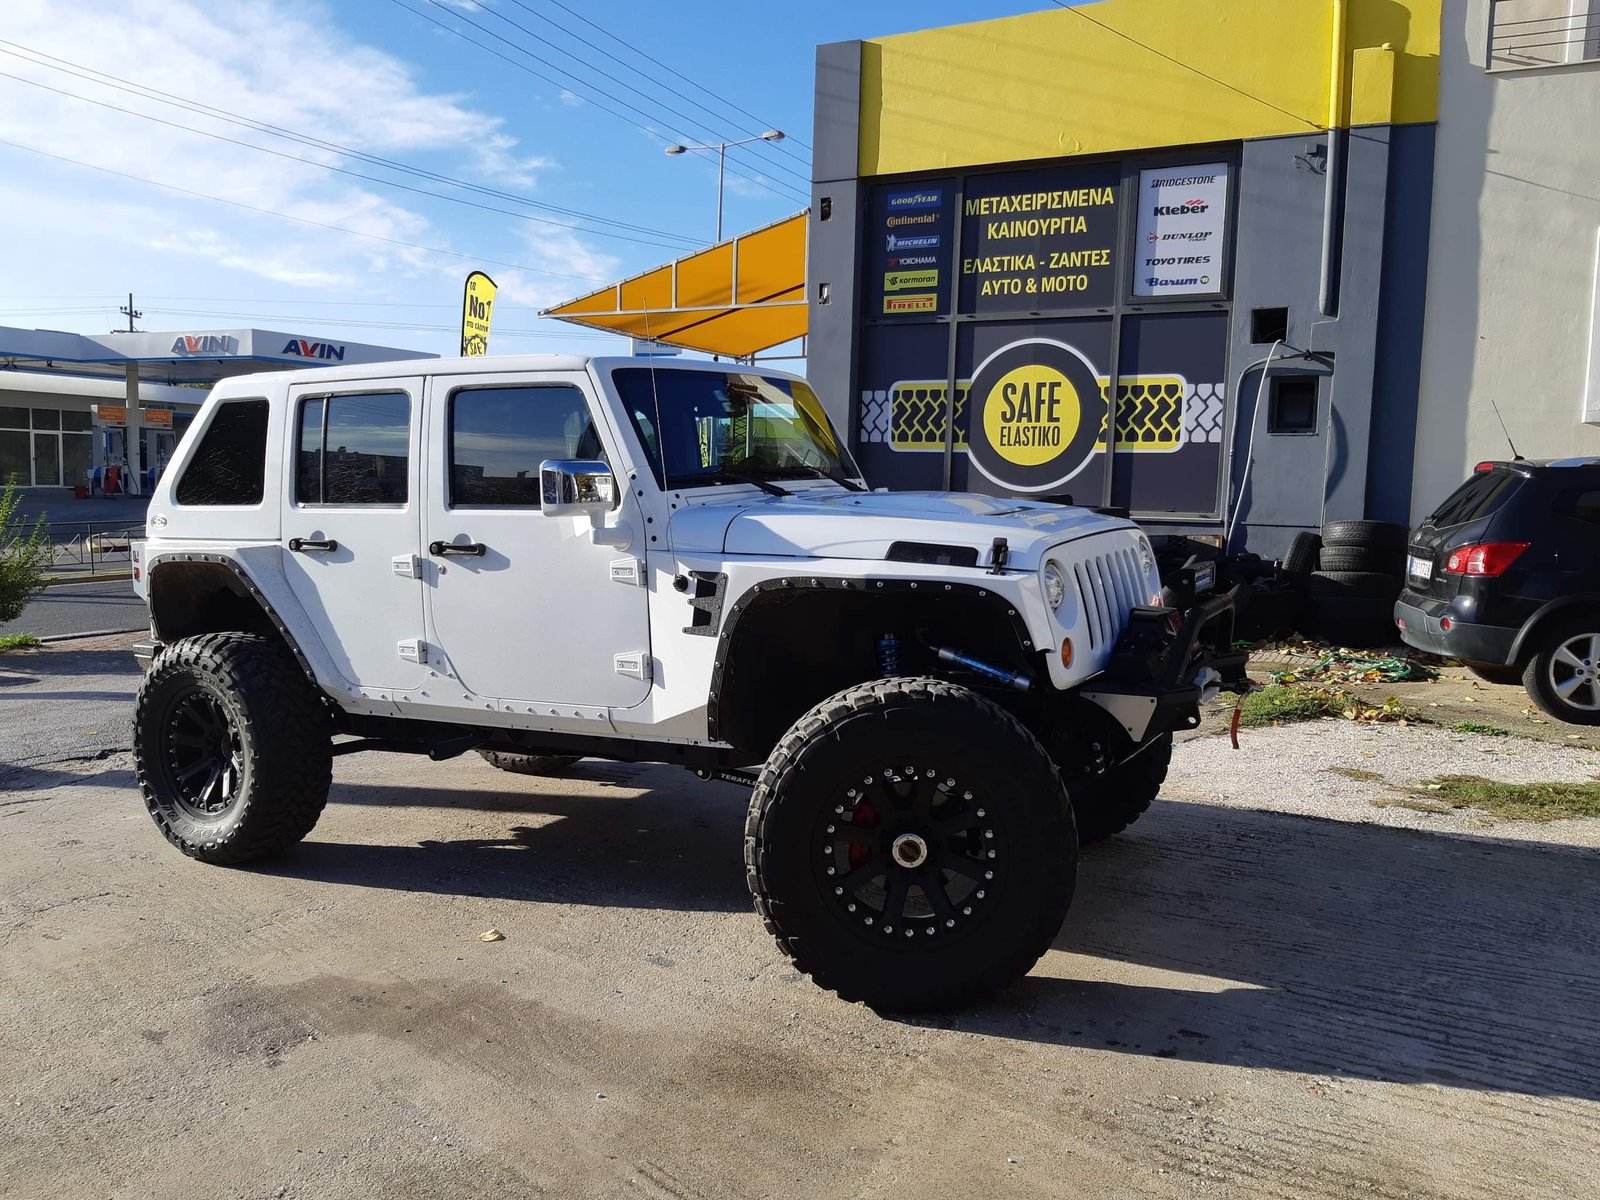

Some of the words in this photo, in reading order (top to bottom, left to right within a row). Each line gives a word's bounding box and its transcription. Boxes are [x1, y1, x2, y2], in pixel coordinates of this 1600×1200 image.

[1151, 175, 1216, 188] BRIDGESTONE
[891, 195, 938, 205] GOODYEAR
[965, 187, 1114, 216] ΜΕΤΑΧΕΙΡΙΣΜΕΝΑ
[1153, 205, 1209, 216] Kleber
[886, 213, 935, 228] Continental
[987, 215, 1088, 240] ΚΑΙΝΟΥΡΓΙΑ
[1162, 231, 1213, 240] DUNLOP
[896, 238, 938, 247] MICHELIN
[899, 256, 937, 265] YOKOHAMA
[963, 254, 1036, 275] ΕΛΑΣΤΙΚΑ
[1049, 249, 1111, 269] ΖΑΝΤΕΣ
[1145, 257, 1176, 267] TOYO
[1177, 256, 1211, 265] TIRES
[899, 276, 936, 285] kormoran
[981, 278, 1022, 297] ΑΥΤΟ
[1025, 278, 1037, 294] &
[1041, 274, 1089, 294] ΜΟΤΟ
[1145, 277, 1198, 287] Barum
[886, 297, 934, 310] PIRELLI
[170, 335, 229, 353] AVIN
[281, 339, 346, 361] AVIN
[1000, 382, 1062, 423] SAFE
[999, 426, 1061, 447] ELASTIKO
